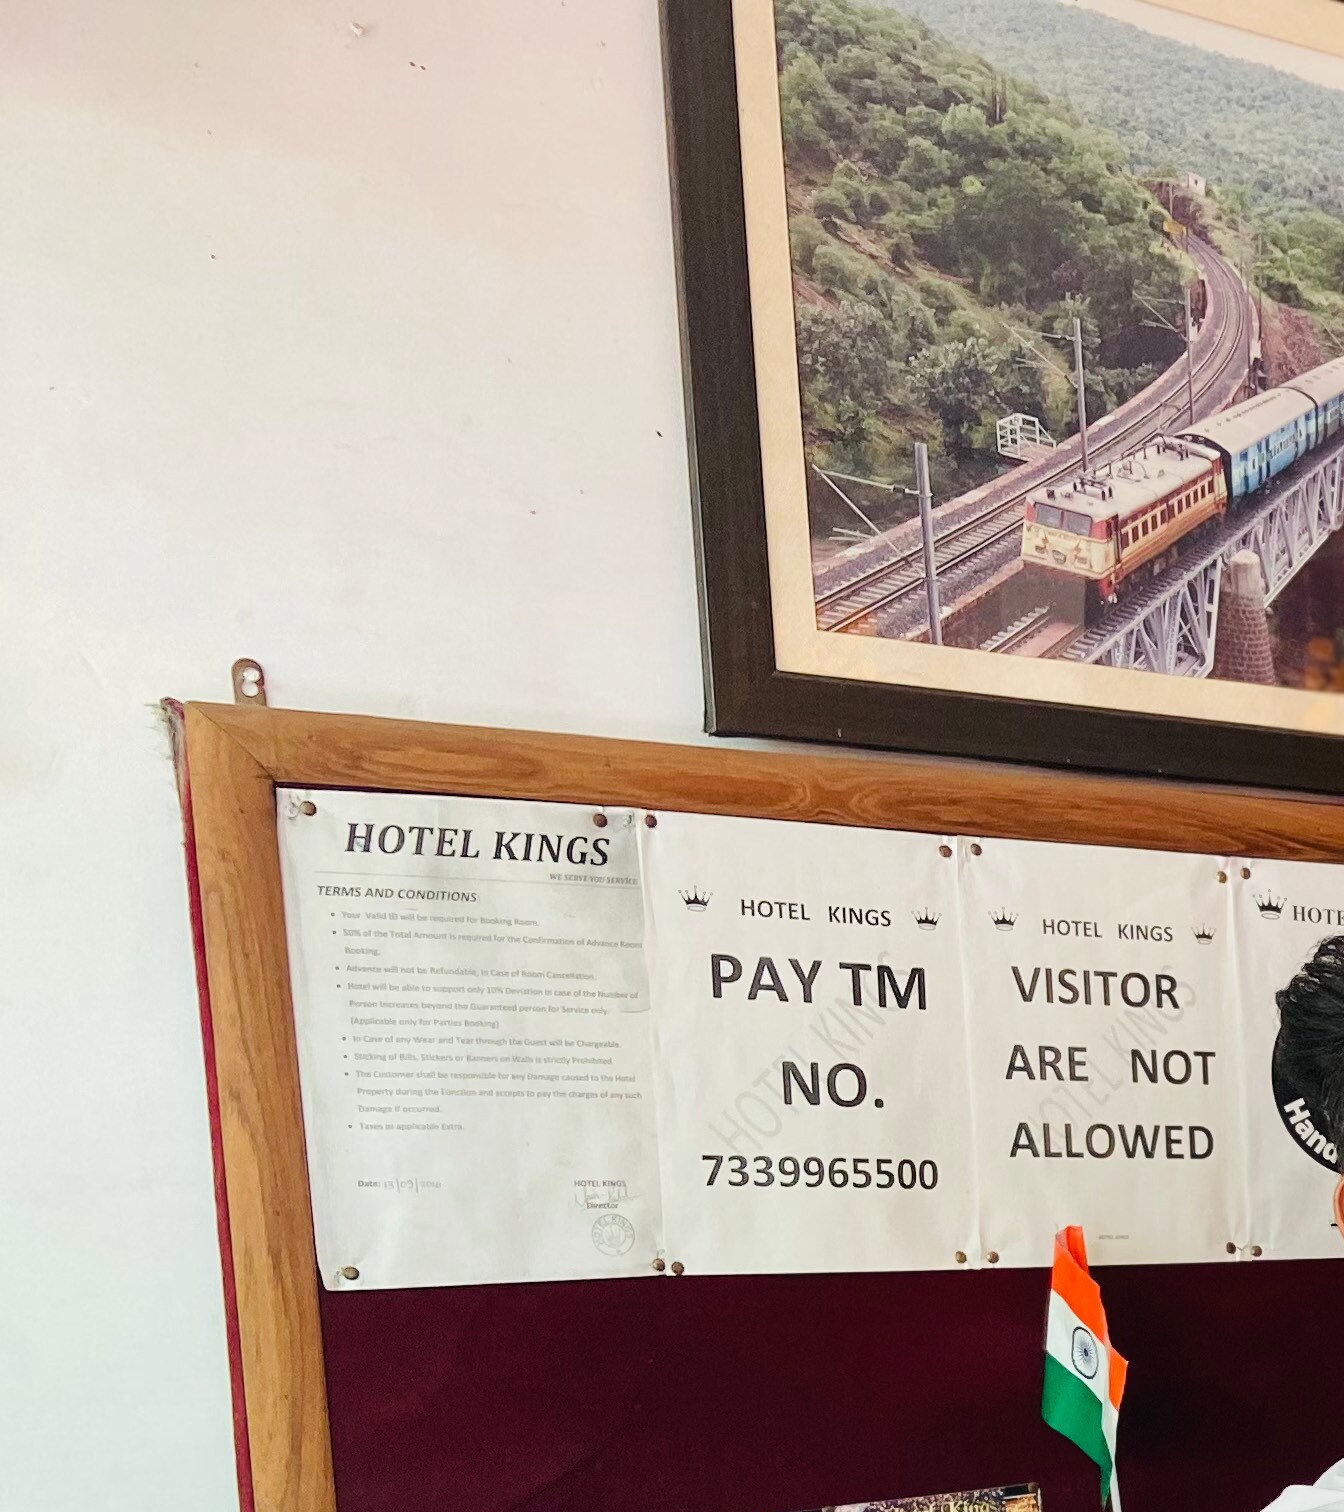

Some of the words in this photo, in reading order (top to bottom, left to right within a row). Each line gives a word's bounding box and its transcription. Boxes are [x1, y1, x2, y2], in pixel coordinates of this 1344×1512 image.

[344, 822, 480, 860] HOTEL
[492, 831, 610, 866] KINGS
[317, 885, 361, 897] TERMS
[364, 888, 394, 898] AND
[365, 912, 386, 920] Valid
[480, 917, 512, 926] Booking
[741, 899, 810, 921] HOTEL
[828, 905, 891, 927] KINGS
[1042, 918, 1102, 938] HOTEL
[1118, 923, 1173, 942] KINGS
[373, 930, 388, 938] the
[711, 953, 822, 1003] PAY
[839, 962, 926, 1010] TM
[1011, 965, 1180, 1009] VISITOR
[1005, 1044, 1088, 1081] ARE
[1131, 1049, 1216, 1085] NOT
[782, 1061, 884, 1108] NO.
[1010, 1122, 1214, 1160] ALLOWED
[702, 1155, 938, 1189] 7339965500
